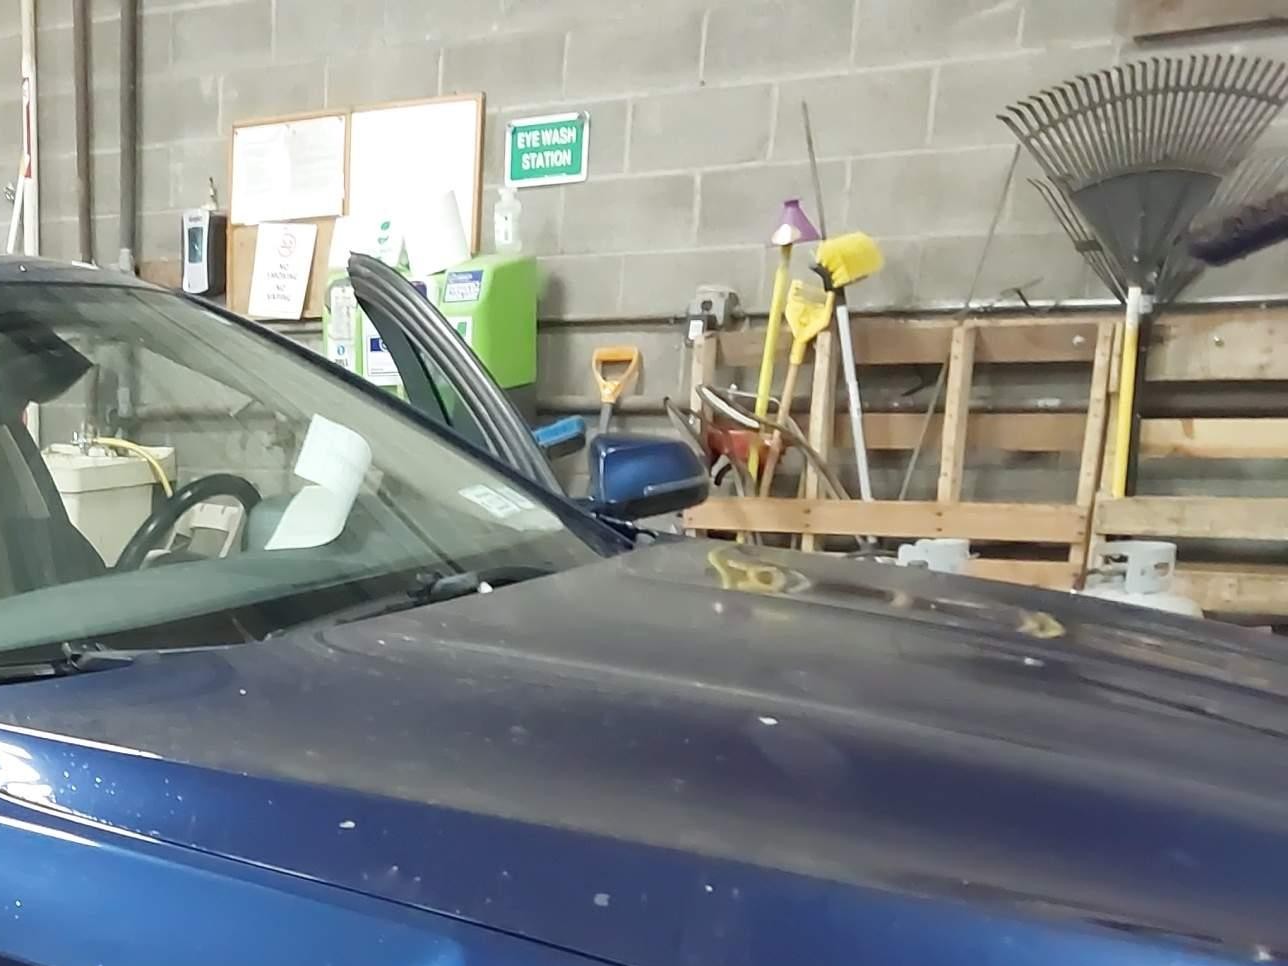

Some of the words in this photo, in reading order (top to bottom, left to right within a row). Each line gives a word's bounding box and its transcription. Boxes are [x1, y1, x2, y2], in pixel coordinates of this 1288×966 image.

[517, 129, 540, 149] EYE
[541, 126, 577, 147] WASH
[521, 149, 572, 170] STATION
